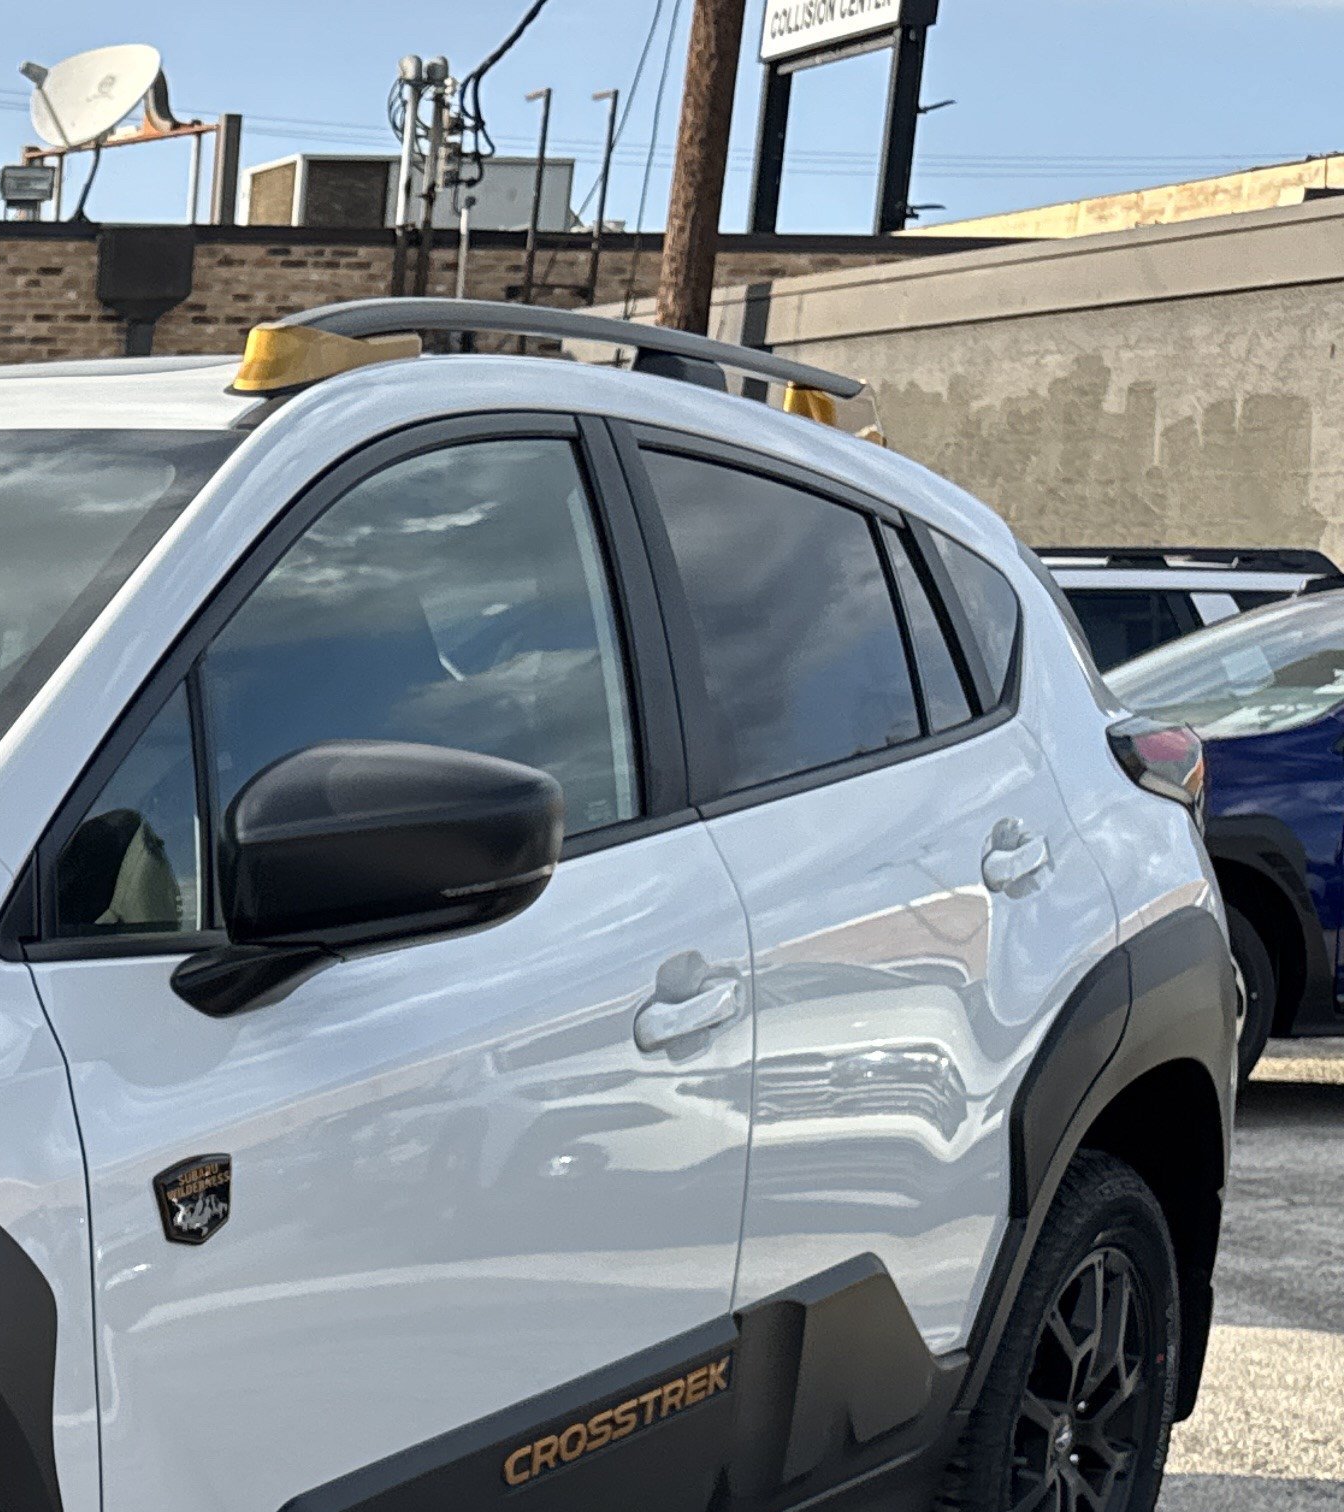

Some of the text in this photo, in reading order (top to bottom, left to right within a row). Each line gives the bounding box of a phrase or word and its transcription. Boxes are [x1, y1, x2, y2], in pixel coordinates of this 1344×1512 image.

[770, 0, 891, 39] COLLISION CEN
[166, 1169, 231, 1201] WILDERNESS
[178, 1163, 219, 1187] SUBARU
[503, 1355, 730, 1487] CROSSTREK
